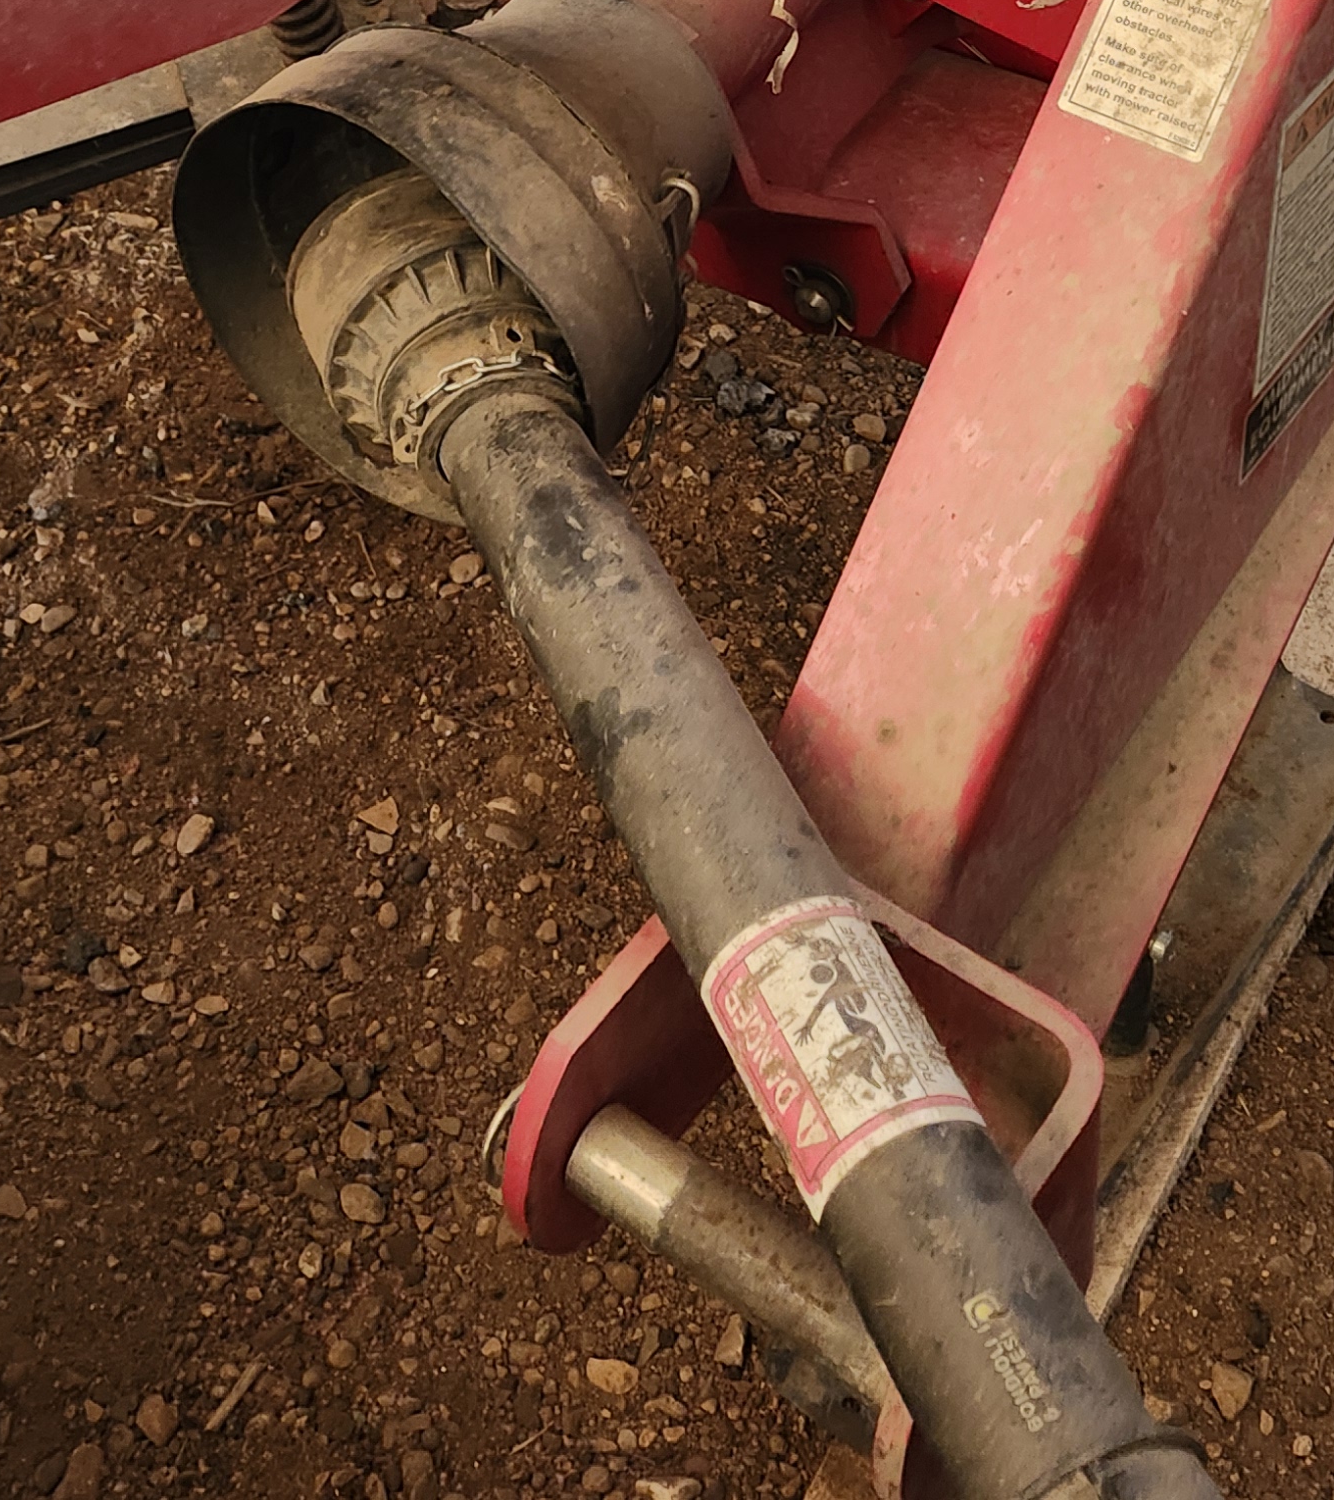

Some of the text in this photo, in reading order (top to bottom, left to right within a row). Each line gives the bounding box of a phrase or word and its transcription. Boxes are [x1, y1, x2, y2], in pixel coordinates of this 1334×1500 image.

[1156, 10, 1214, 38] overhead
[1185, 1, 1220, 22] wires
[1221, 16, 1237, 27] or
[1097, 52, 1193, 96] clearance whn
[1103, 36, 1184, 73] Make sure of
[1083, 81, 1111, 99] with
[1112, 93, 1155, 116] mower
[1089, 66, 1180, 109] moving tractor
[1260, 325, 1324, 418] MIDWAY
[884, 1002, 937, 1087] ROTATING
[981, 1336, 1046, 1434] BONDIOLI
[996, 1327, 1063, 1424] & PAVESI
